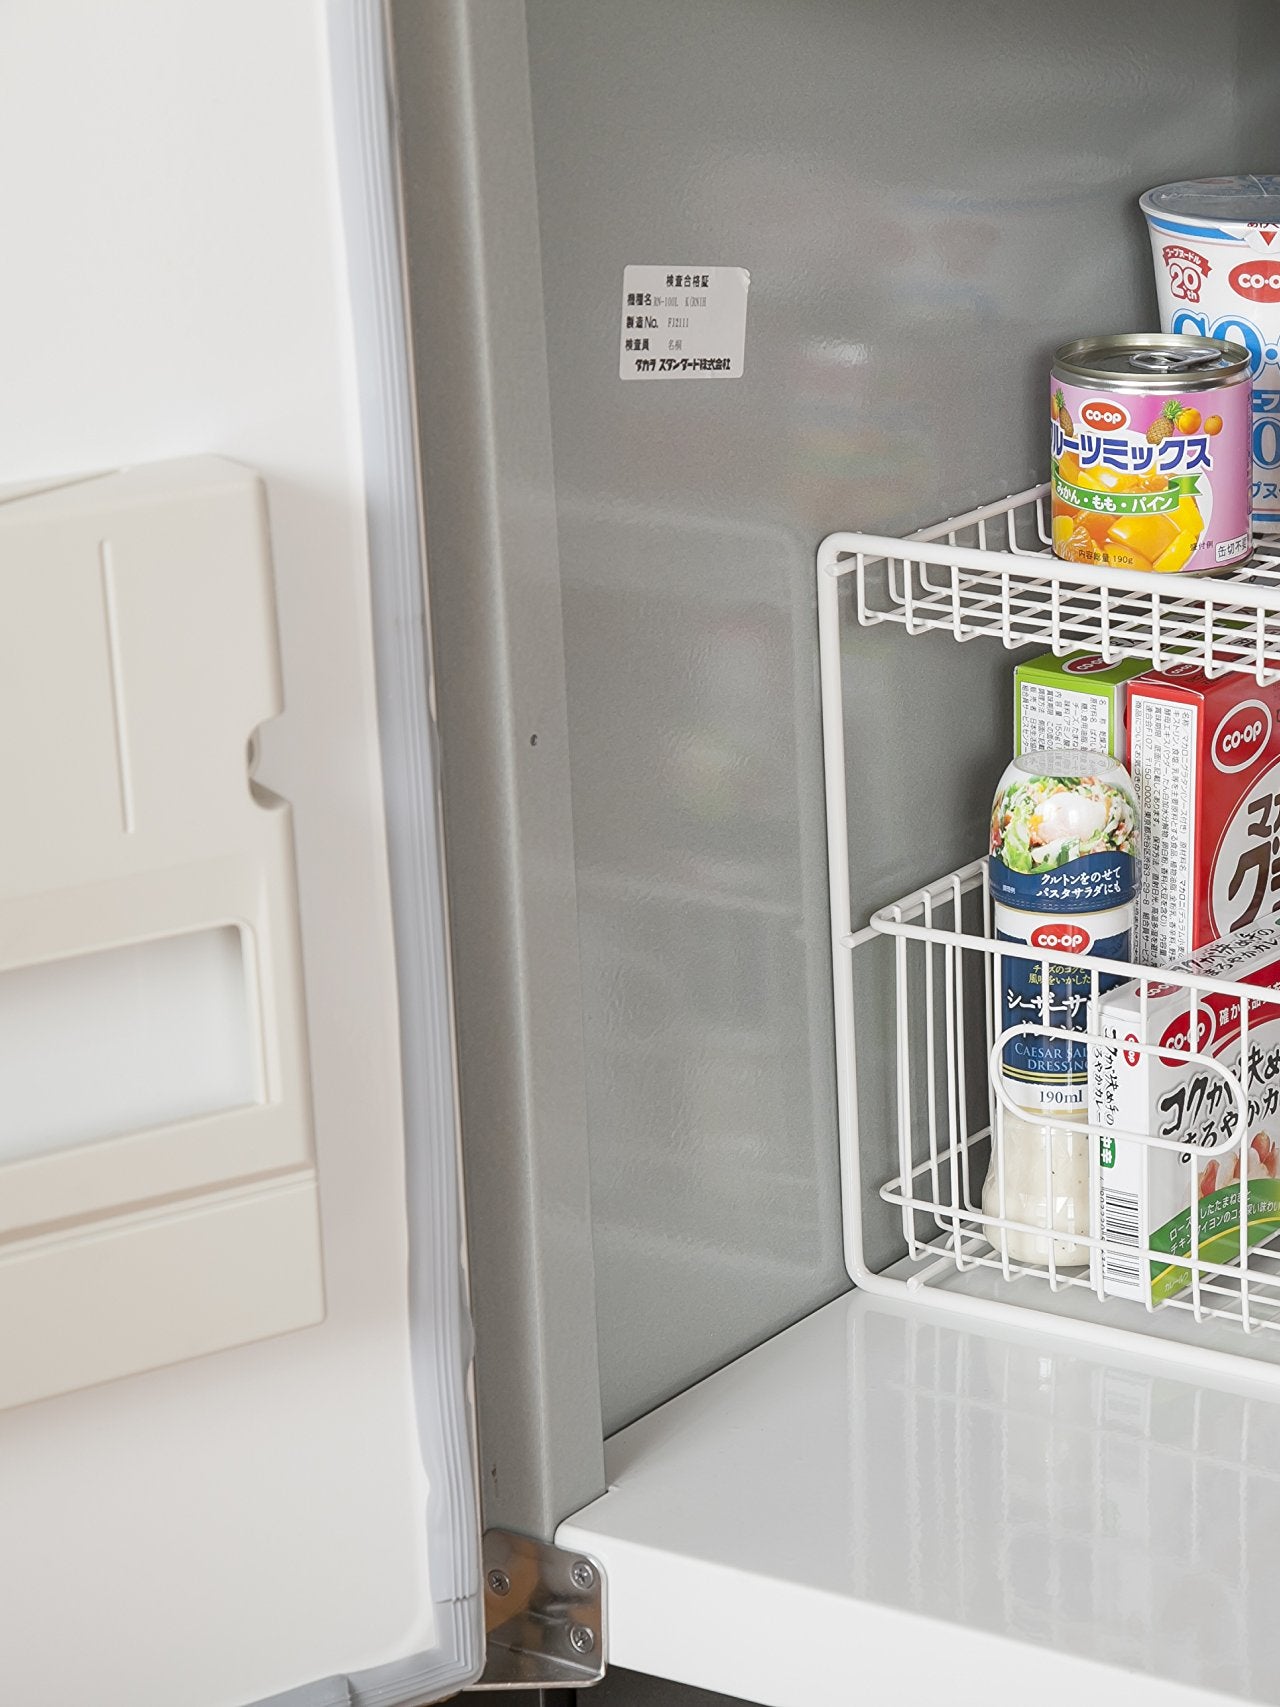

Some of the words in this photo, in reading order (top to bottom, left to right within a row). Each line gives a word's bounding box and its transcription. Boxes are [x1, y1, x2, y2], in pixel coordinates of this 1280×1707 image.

[666, 274, 710, 288] 検査合格証
[627, 293, 652, 306] 機種名
[625, 338, 649, 351] 検査員
[1113, 555, 1134, 565] 190g
[1040, 866, 1122, 885] クルトンをのせて
[1036, 880, 1122, 900] パスタサラダにも
[1014, 1042, 1062, 1059] CAESAR
[1039, 1089, 1083, 1104] 190ml
